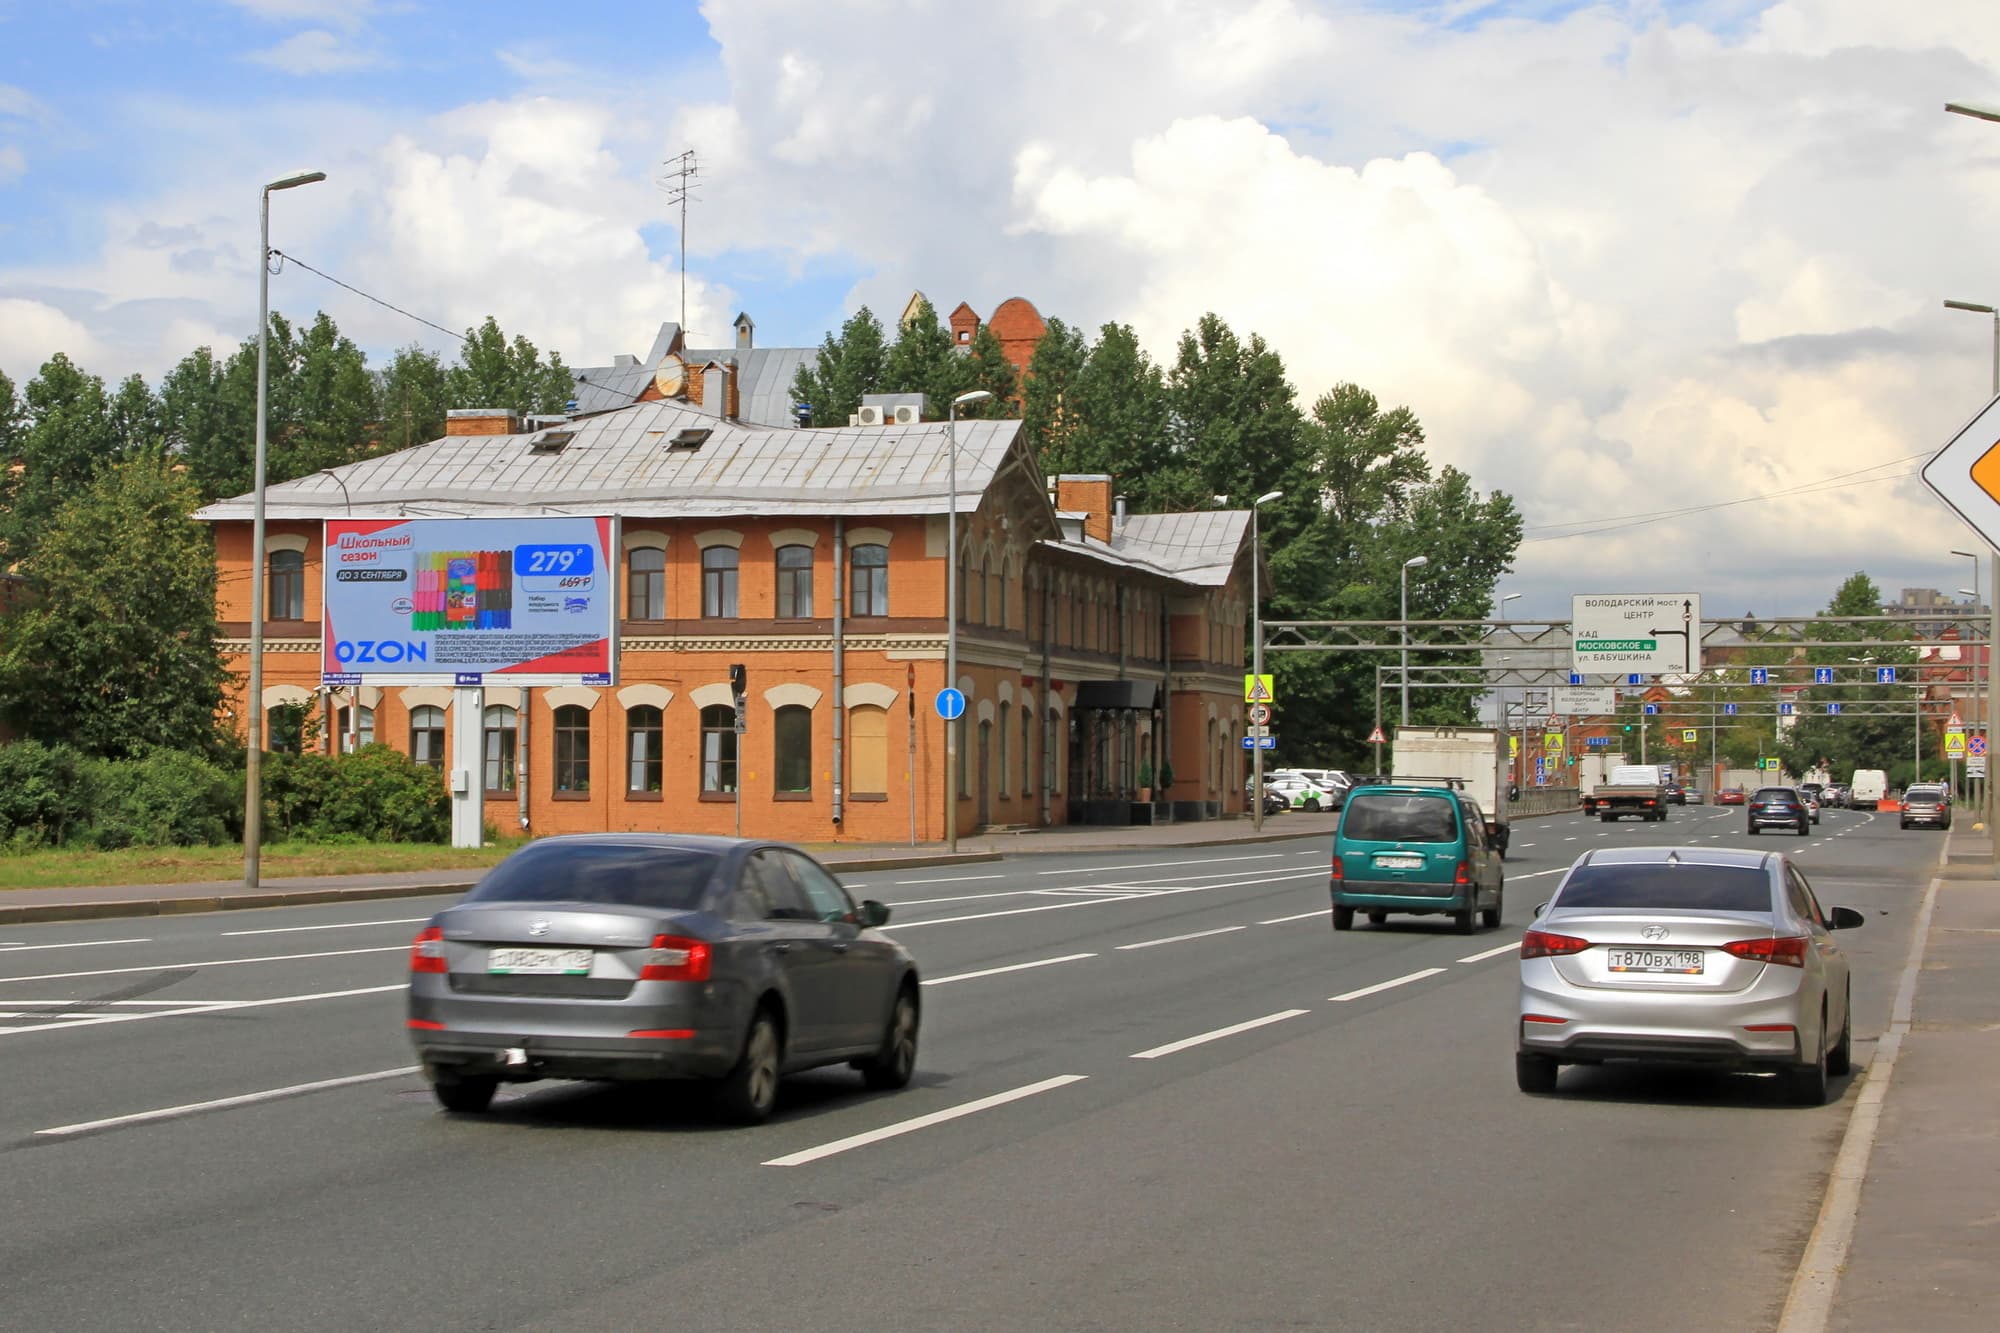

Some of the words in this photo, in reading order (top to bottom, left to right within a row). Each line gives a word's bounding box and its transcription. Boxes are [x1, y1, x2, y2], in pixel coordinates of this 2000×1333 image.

[340, 533, 411, 550] Школьный
[340, 552, 377, 562] сезон
[528, 550, 575, 572] 279
[338, 571, 352, 580] ДО
[353, 571, 359, 579] 3
[360, 571, 402, 579] СЕНТЯБРЯ
[559, 577, 580, 588] 469
[1585, 596, 1654, 608] ВОЛОДАРСКИЙ
[1624, 611, 1654, 620] ЦЕНТР
[1578, 631, 1598, 639] КАД
[1578, 641, 1641, 650] МОСКОВСКОЕ
[335, 640, 427, 663] OZON
[1578, 655, 1590, 663] ул.
[1593, 653, 1652, 661] БАБУШКИНА
[1614, 951, 1673, 967] Т870ВХ
[1677, 952, 1700, 964] 198
